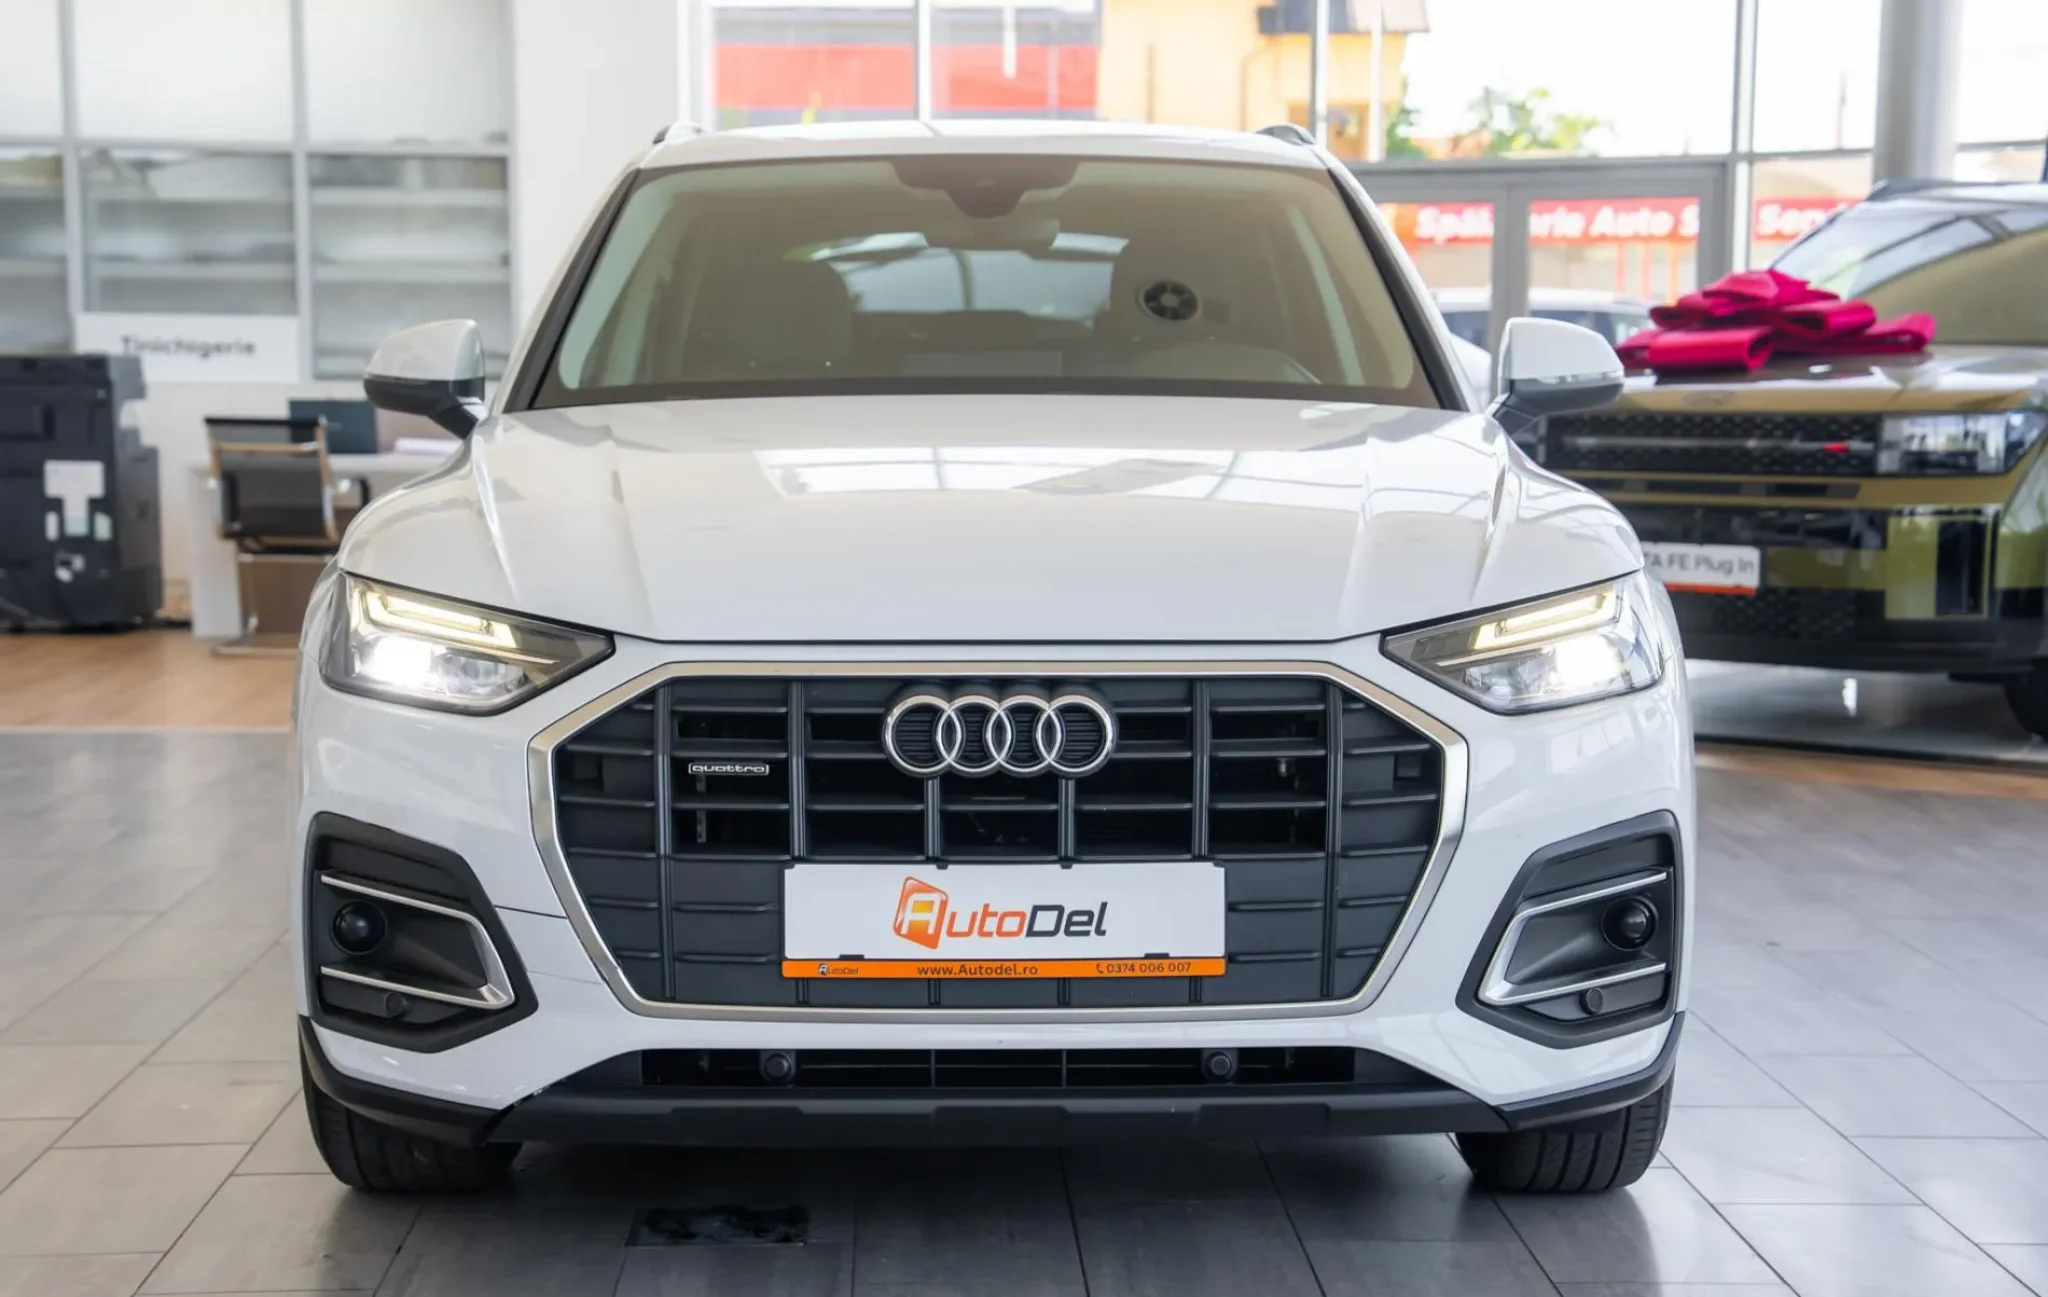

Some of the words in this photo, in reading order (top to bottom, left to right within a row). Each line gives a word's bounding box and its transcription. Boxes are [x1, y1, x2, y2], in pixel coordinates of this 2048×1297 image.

[1589, 205, 1675, 237] Auto
[1666, 552, 1692, 571] FE
[1694, 553, 1734, 577] Plug
[692, 764, 765, 773] quattro
[896, 886, 1108, 942] AutoDel
[917, 964, 1038, 976] www.Autodel.ro
[1106, 963, 1135, 974] 0374
[1139, 963, 1165, 973] 006
[1167, 962, 1191, 972] 007
